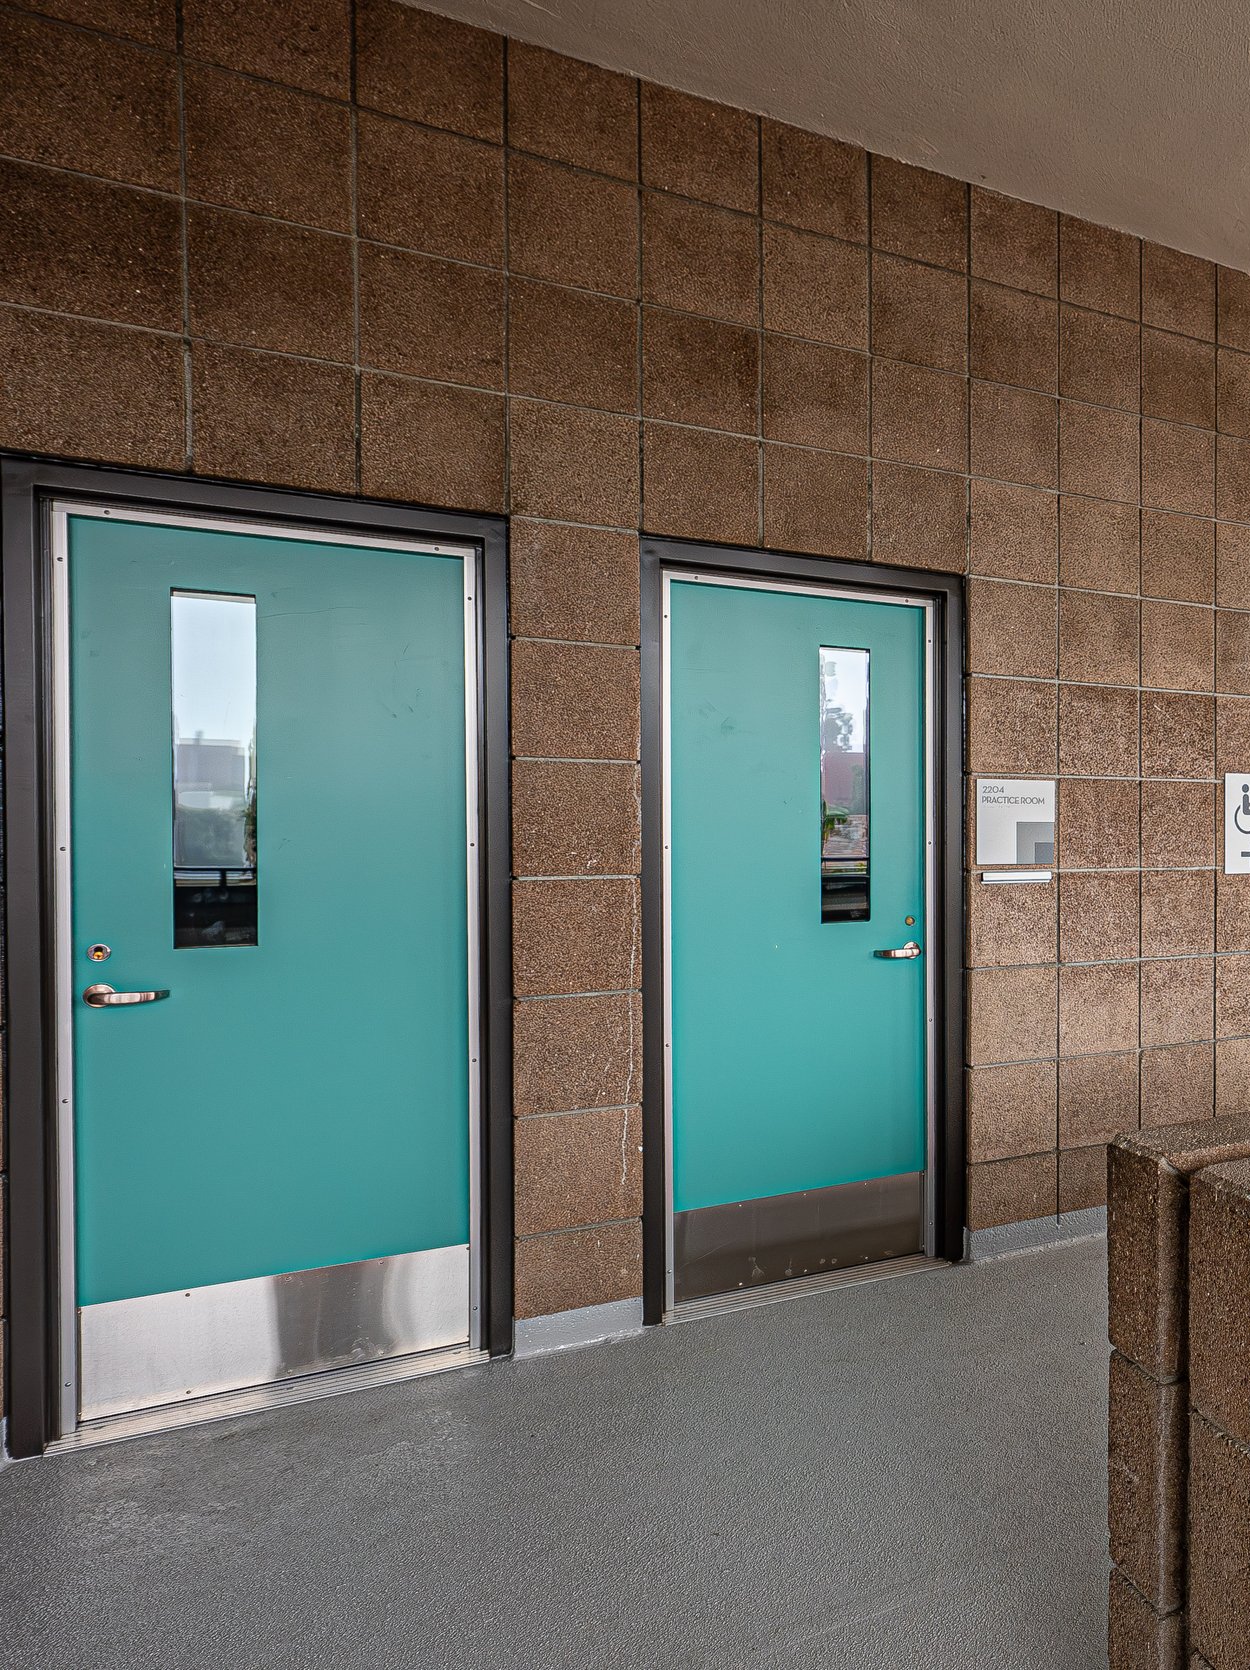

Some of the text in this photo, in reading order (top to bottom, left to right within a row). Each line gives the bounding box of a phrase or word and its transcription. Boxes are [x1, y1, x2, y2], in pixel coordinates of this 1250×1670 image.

[982, 785, 1004, 794] 2204
[981, 795, 1045, 805] PRACTICE ROOM
